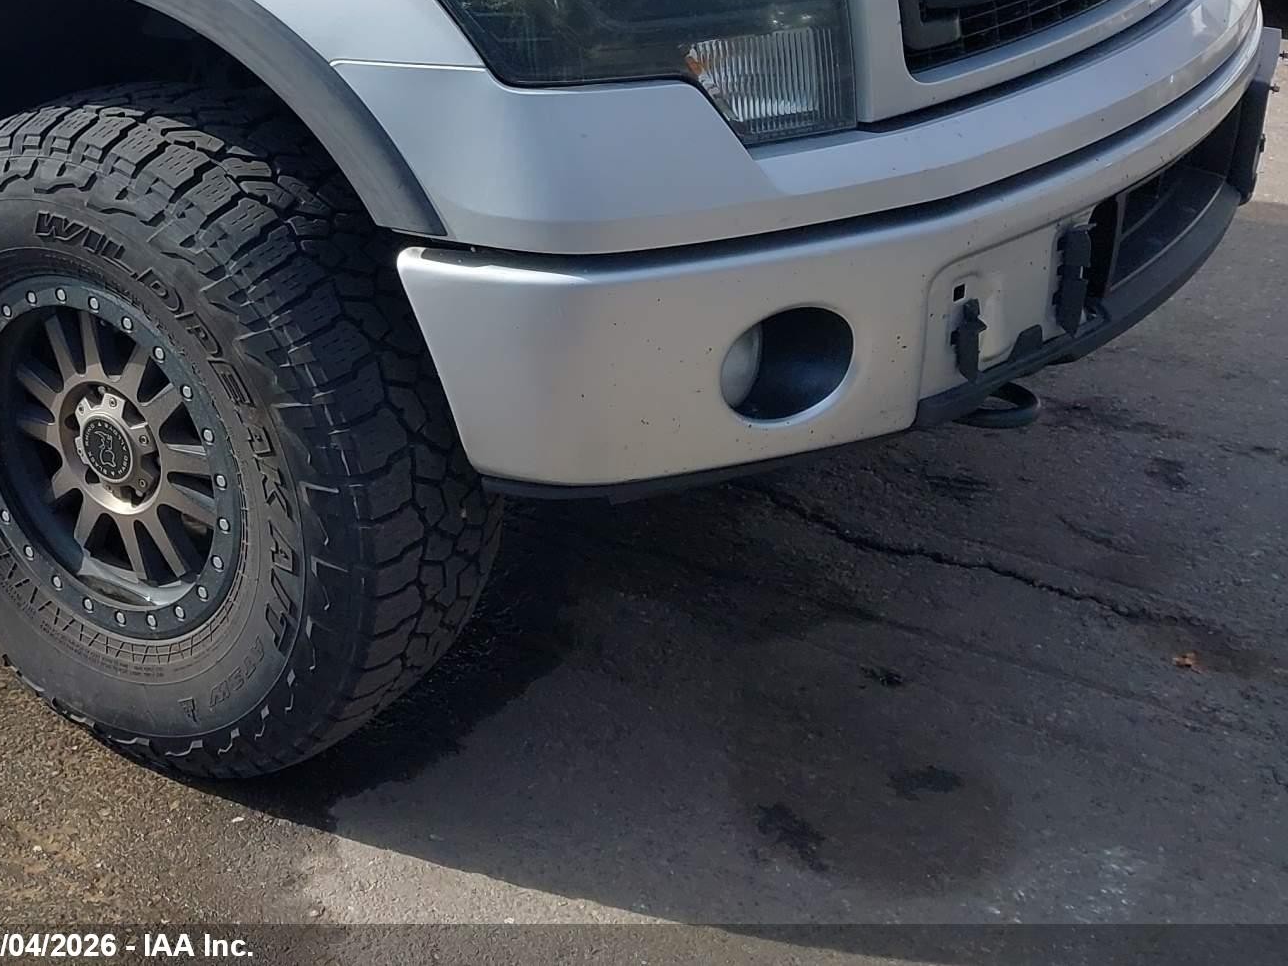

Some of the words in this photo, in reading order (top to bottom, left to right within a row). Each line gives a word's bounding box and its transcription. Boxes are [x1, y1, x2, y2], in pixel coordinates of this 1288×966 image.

[34, 208, 294, 522] WILDPEAK
[84, 423, 95, 446] RHINO
[117, 455, 129, 475] HARD
